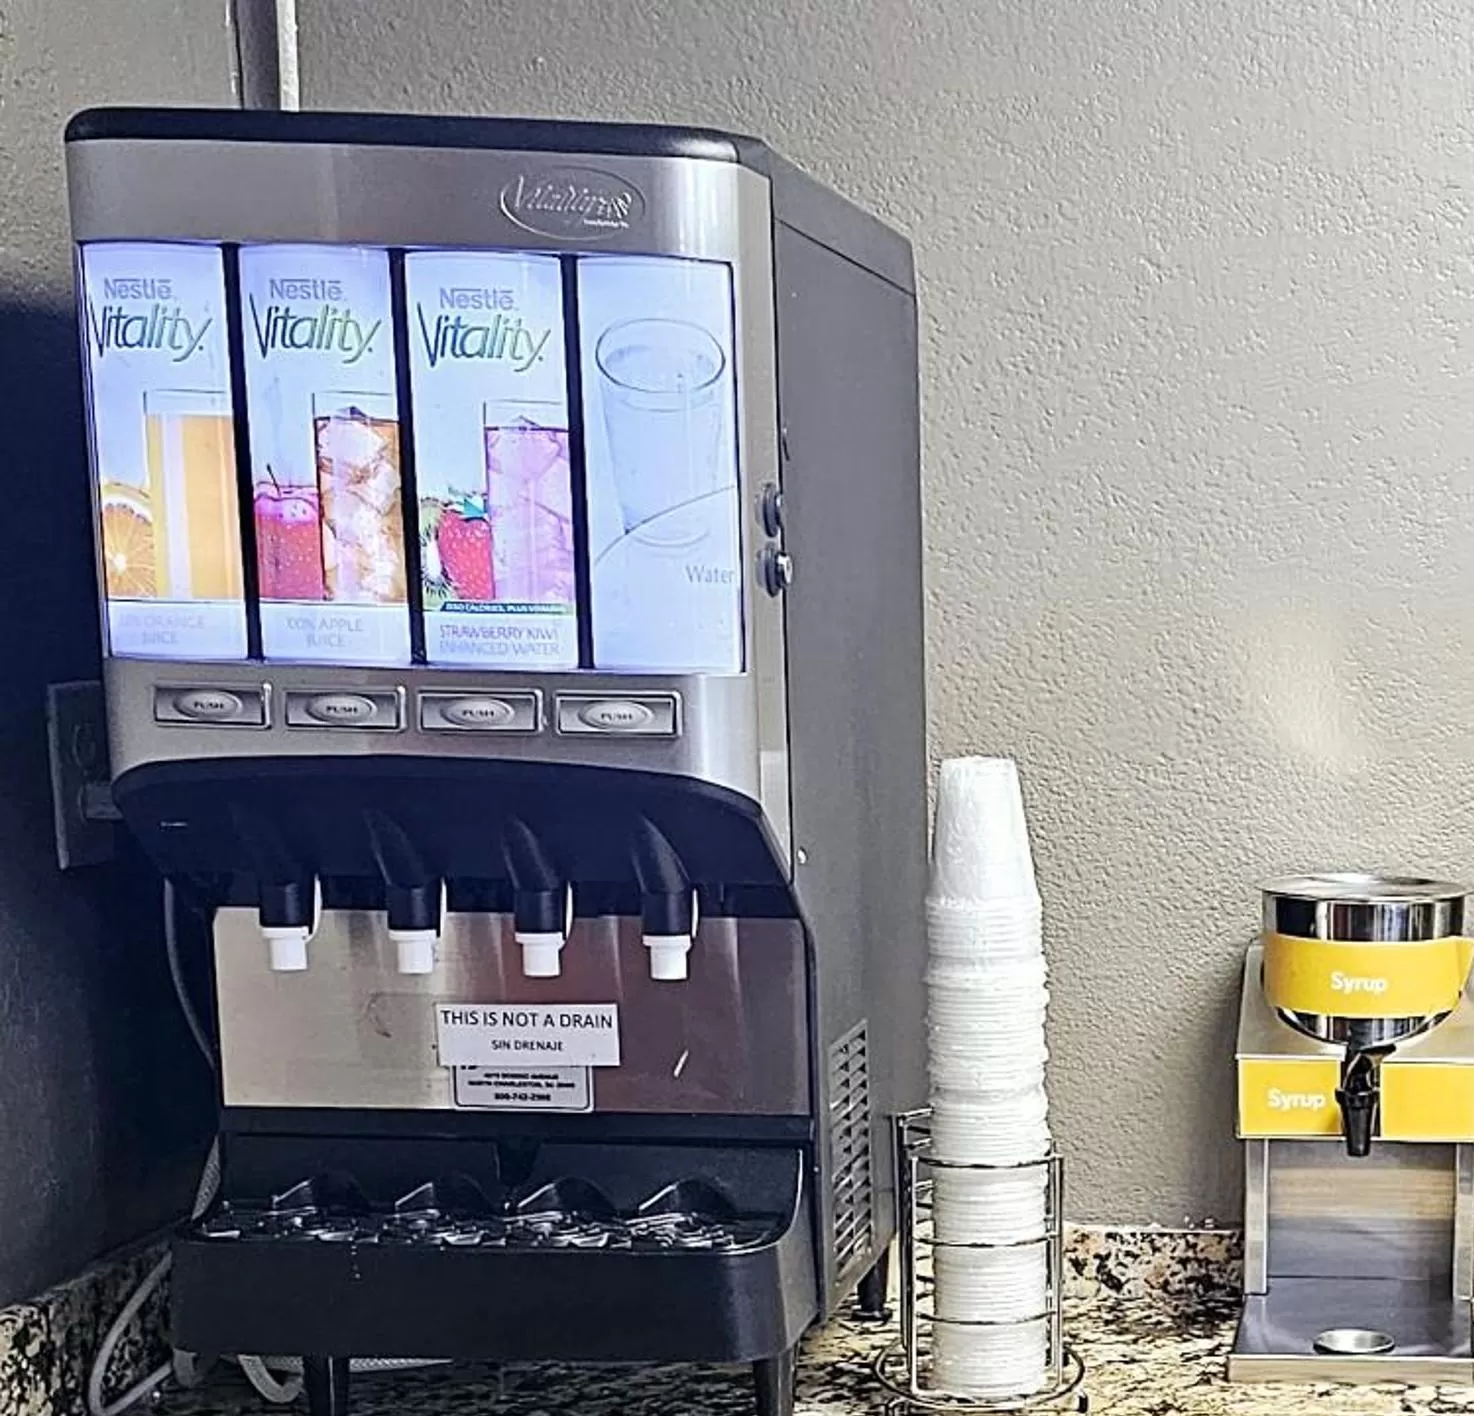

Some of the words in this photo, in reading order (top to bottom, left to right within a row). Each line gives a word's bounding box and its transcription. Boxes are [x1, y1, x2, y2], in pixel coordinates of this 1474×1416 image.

[685, 564, 736, 585] Water
[317, 617, 365, 632] APPLE
[439, 624, 523, 640] STRAWBERRY
[1330, 970, 1389, 995] Syrup
[441, 1010, 479, 1025] THIS
[483, 1012, 498, 1026] IS
[502, 1012, 539, 1028] NOT
[543, 1013, 555, 1028] A
[559, 1013, 613, 1029] DRAIN
[491, 1039, 511, 1051] SIN
[514, 1039, 564, 1052] DRENAJE
[1267, 1087, 1327, 1112] Syrup
